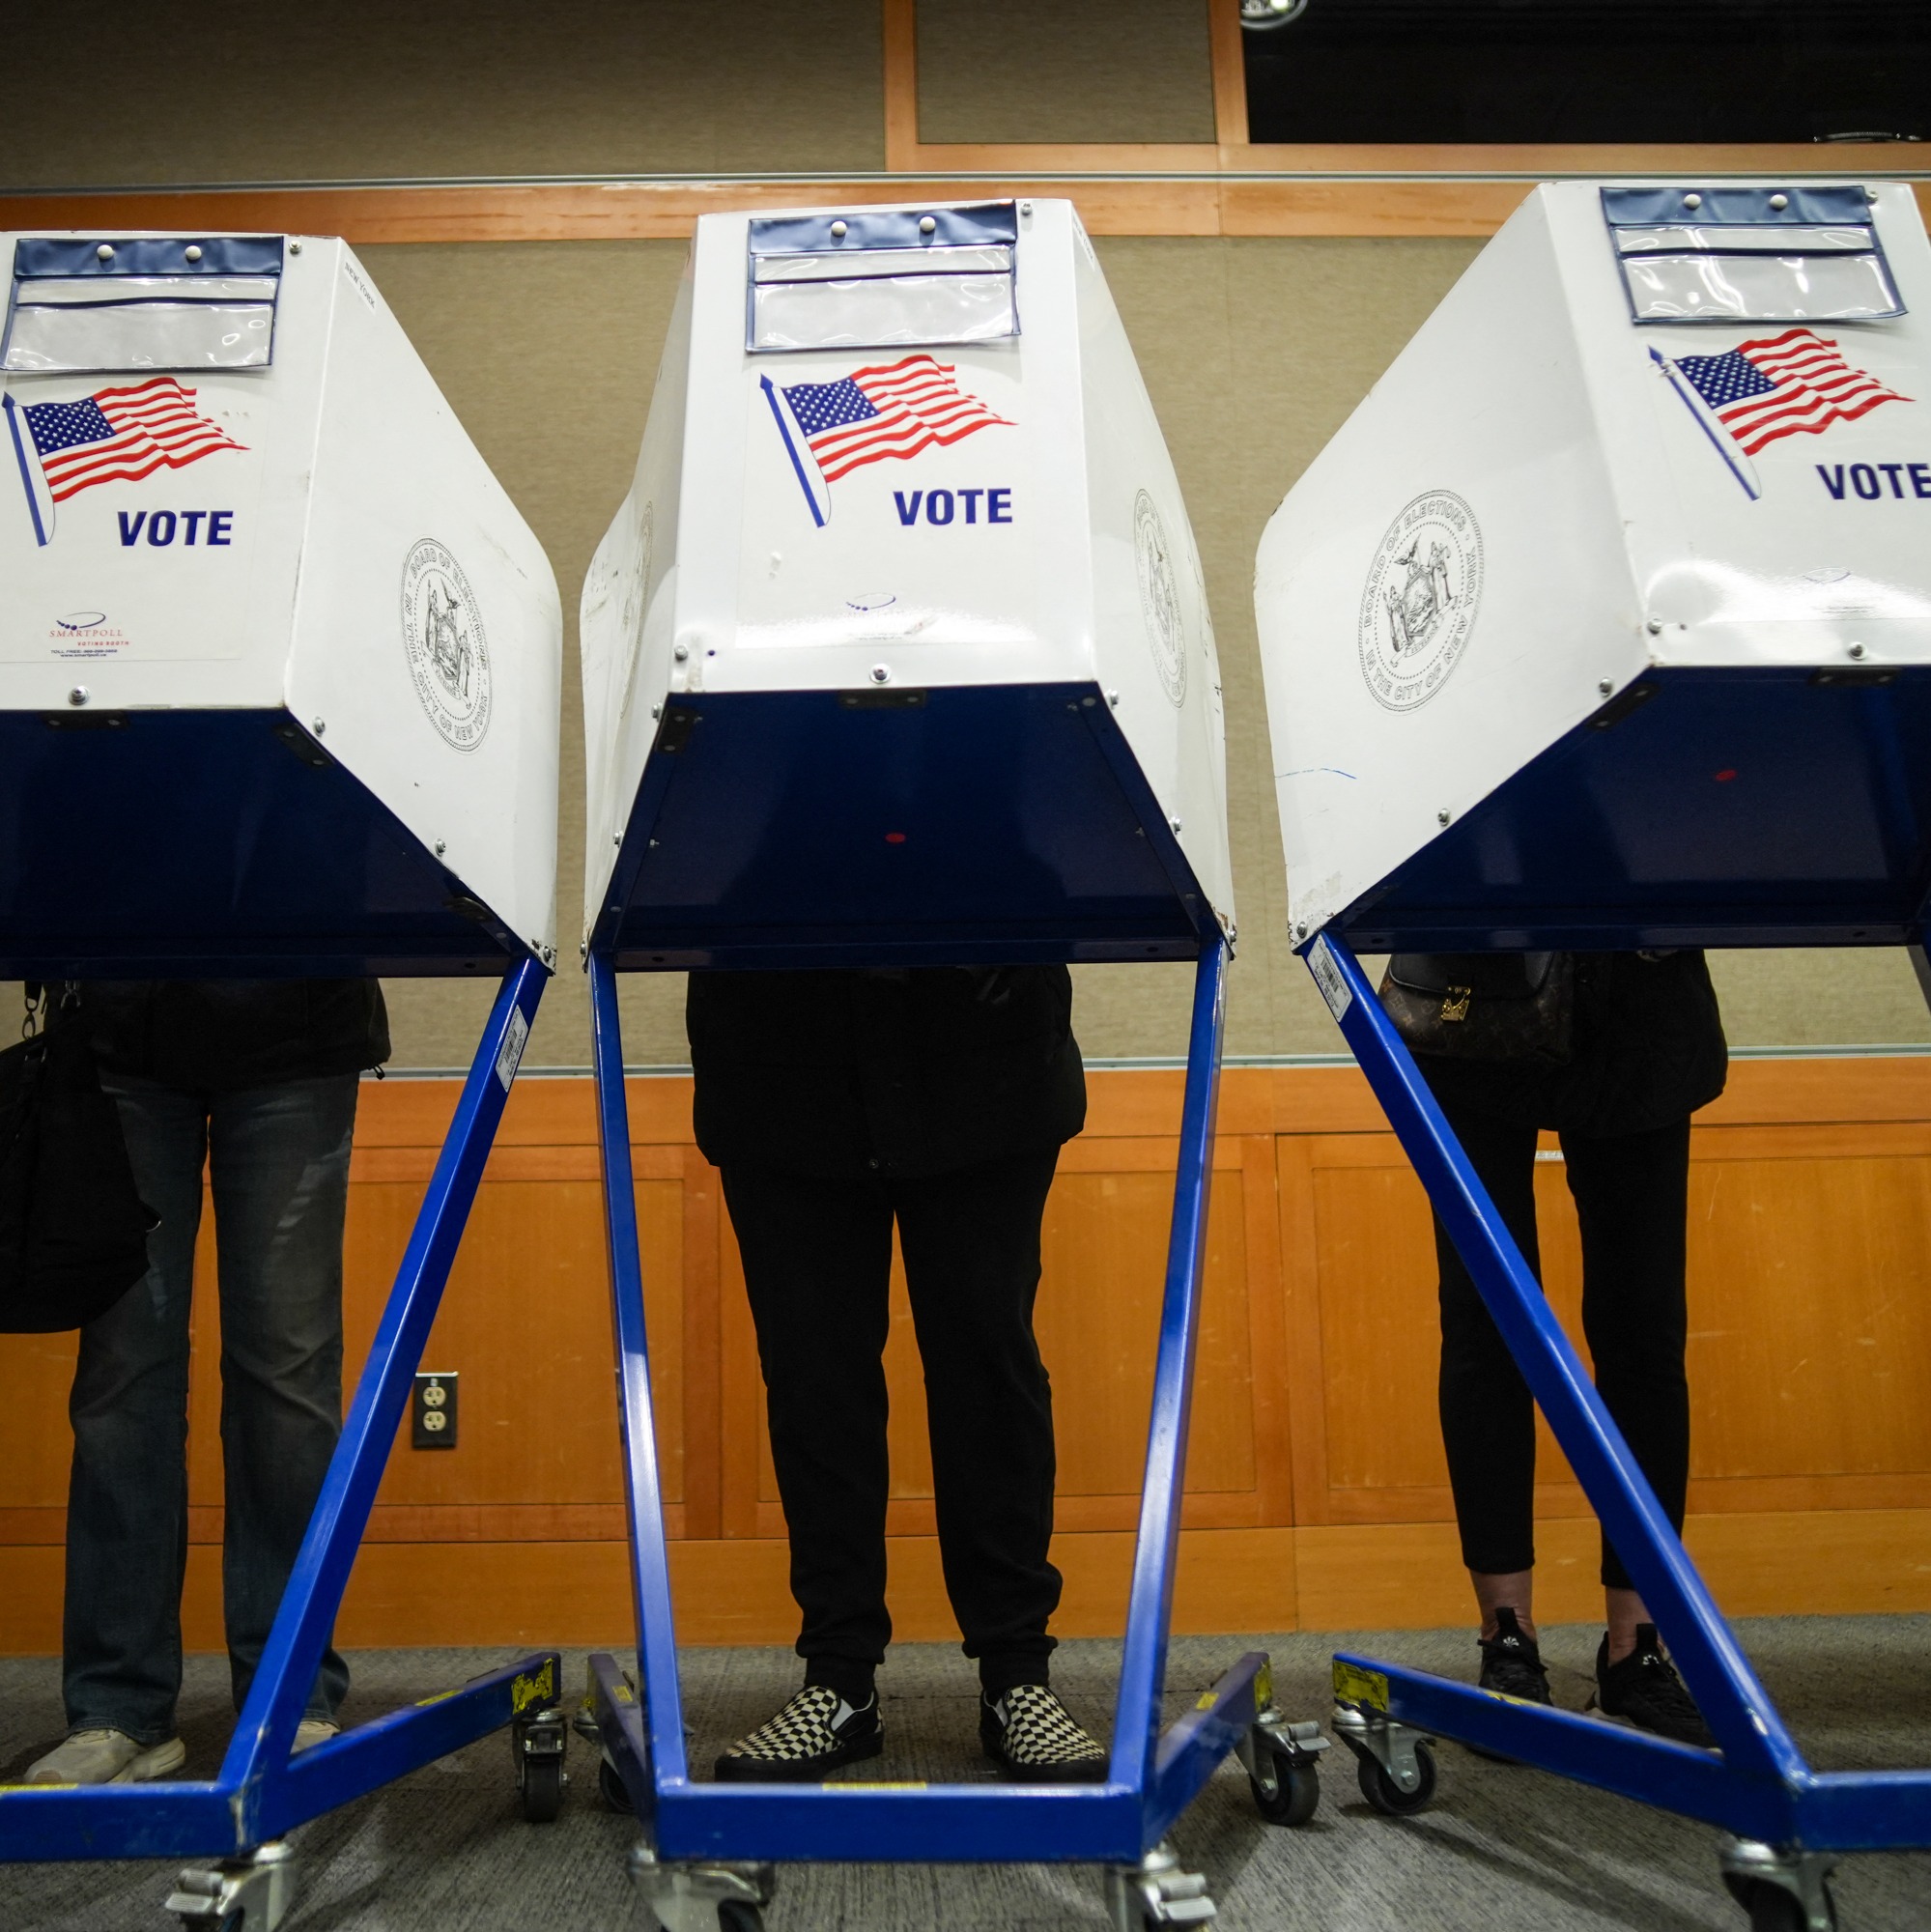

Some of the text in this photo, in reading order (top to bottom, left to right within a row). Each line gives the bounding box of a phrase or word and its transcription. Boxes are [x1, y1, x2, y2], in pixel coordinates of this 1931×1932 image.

[359, 281, 375, 309] YORK
[1815, 463, 1931, 500] VOTE
[894, 488, 1012, 526] VOTE
[118, 510, 234, 547] VOTE
[410, 548, 437, 579] BOARD
[439, 552, 451, 570] OF
[1364, 499, 1466, 627] BOARD OF ELECTIONS
[405, 591, 412, 616] IN
[49, 629, 123, 638] SMARTPOLL
[1366, 649, 1377, 671] IN
[1373, 668, 1393, 696] THE
[1394, 680, 1423, 700] CITY
[1425, 663, 1441, 688] OF
[1443, 614, 1467, 665] NEW
[1463, 546, 1477, 608] YORK
[407, 622, 419, 664] THE
[417, 670, 440, 715] CITY
[440, 713, 452, 733] OF
[454, 724, 474, 741] NEW
